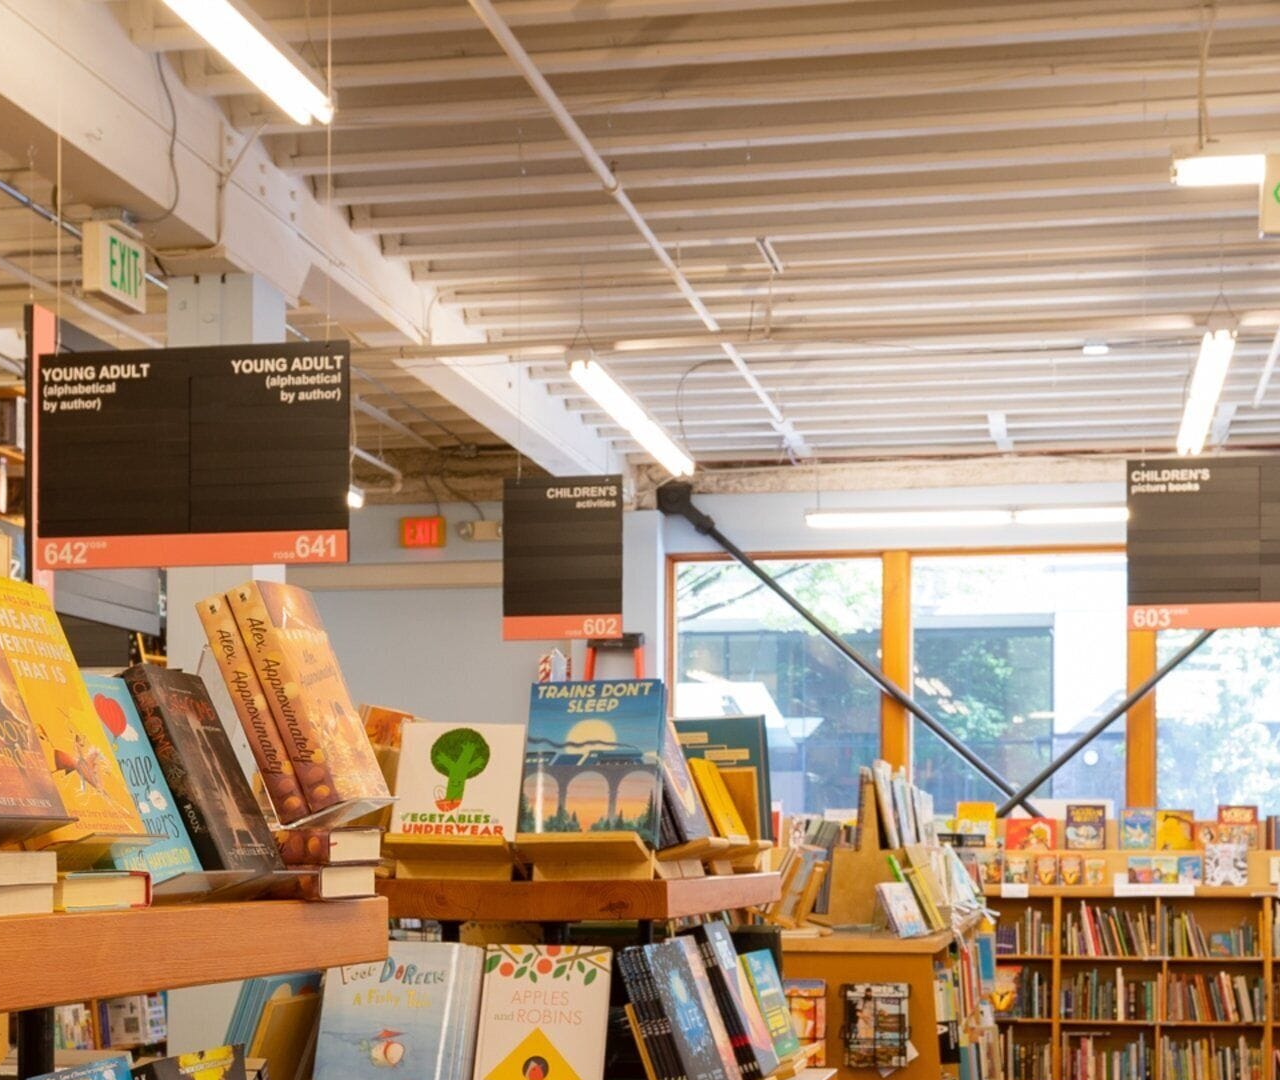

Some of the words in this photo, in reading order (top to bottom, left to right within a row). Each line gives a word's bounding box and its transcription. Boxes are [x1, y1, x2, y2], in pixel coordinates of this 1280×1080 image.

[107, 235, 141, 299] EXIT
[41, 366, 96, 382] YOUNG
[99, 363, 151, 380] ADULT
[231, 359, 288, 375] YOUNG
[291, 355, 345, 372] ADULT
[265, 372, 342, 389] (alphabetical
[42, 381, 116, 398] (alphabetical
[280, 389, 296, 404] by
[298, 387, 342, 402] author)
[42, 399, 58, 414] by
[59, 397, 102, 412] author)
[1131, 468, 1211, 483] CHILDREN'S
[546, 485, 618, 499] CHILDREN'S
[1130, 482, 1166, 494] picture
[1168, 480, 1200, 492] books
[575, 499, 617, 509] activities
[405, 518, 440, 545] EXIT
[44, 542, 88, 565] 642
[295, 535, 338, 558] 641
[583, 617, 618, 636] 602
[1132, 608, 1172, 628] 603
[11, 658, 50, 681] THAT
[50, 665, 67, 684] IS
[537, 684, 598, 700] TRAINS
[600, 681, 654, 699] DON'T
[566, 698, 620, 714] SLEEP
[400, 811, 491, 825] VEGETABLES
[401, 823, 504, 837] UNDERWEAR
[510, 990, 571, 1007] APPLES
[493, 1011, 515, 1024] and
[515, 1008, 583, 1026] ROBINS
